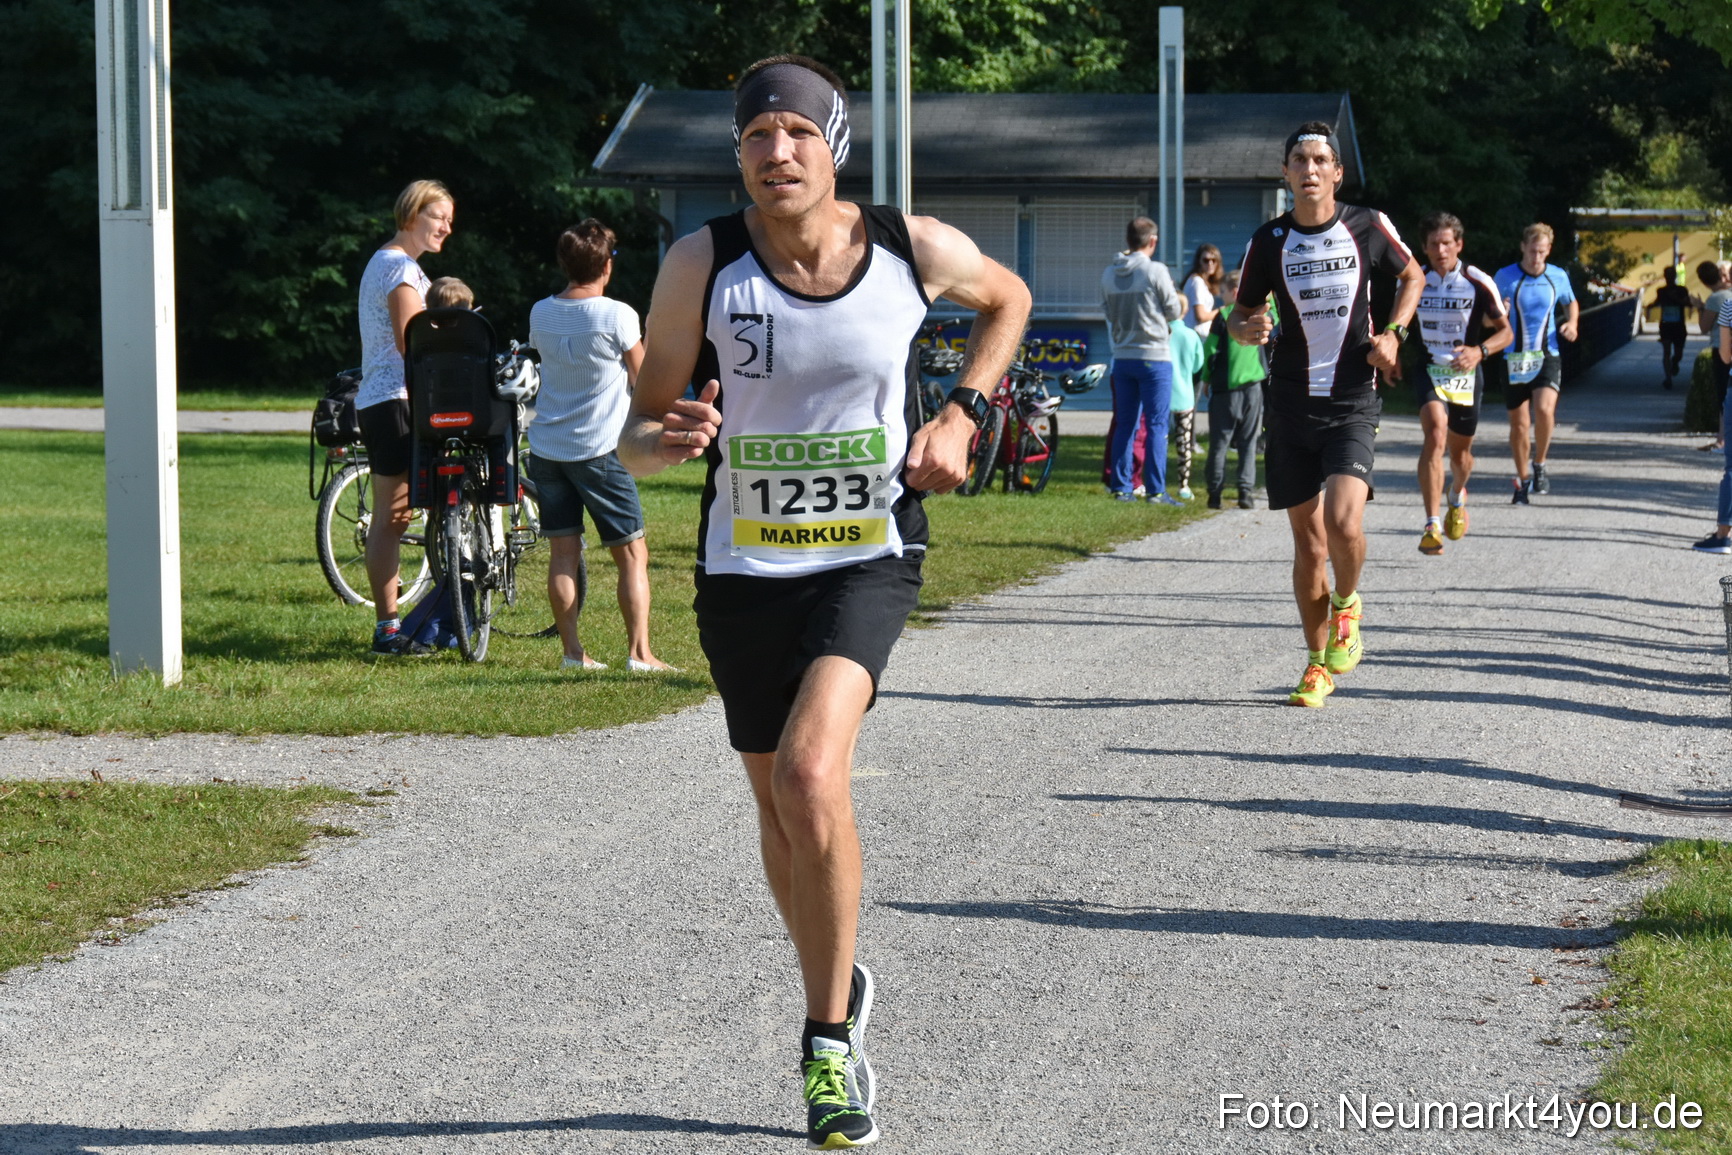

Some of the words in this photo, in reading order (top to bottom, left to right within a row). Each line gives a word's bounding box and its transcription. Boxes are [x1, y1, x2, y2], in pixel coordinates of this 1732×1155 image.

[1287, 257, 1355, 276] POSITIV
[1420, 297, 1472, 309] OSITIV
[766, 313, 774, 373] SCHWANDORF
[741, 434, 875, 465] BOCK
[750, 474, 870, 515] 1233
[760, 525, 861, 544] MARKUS
